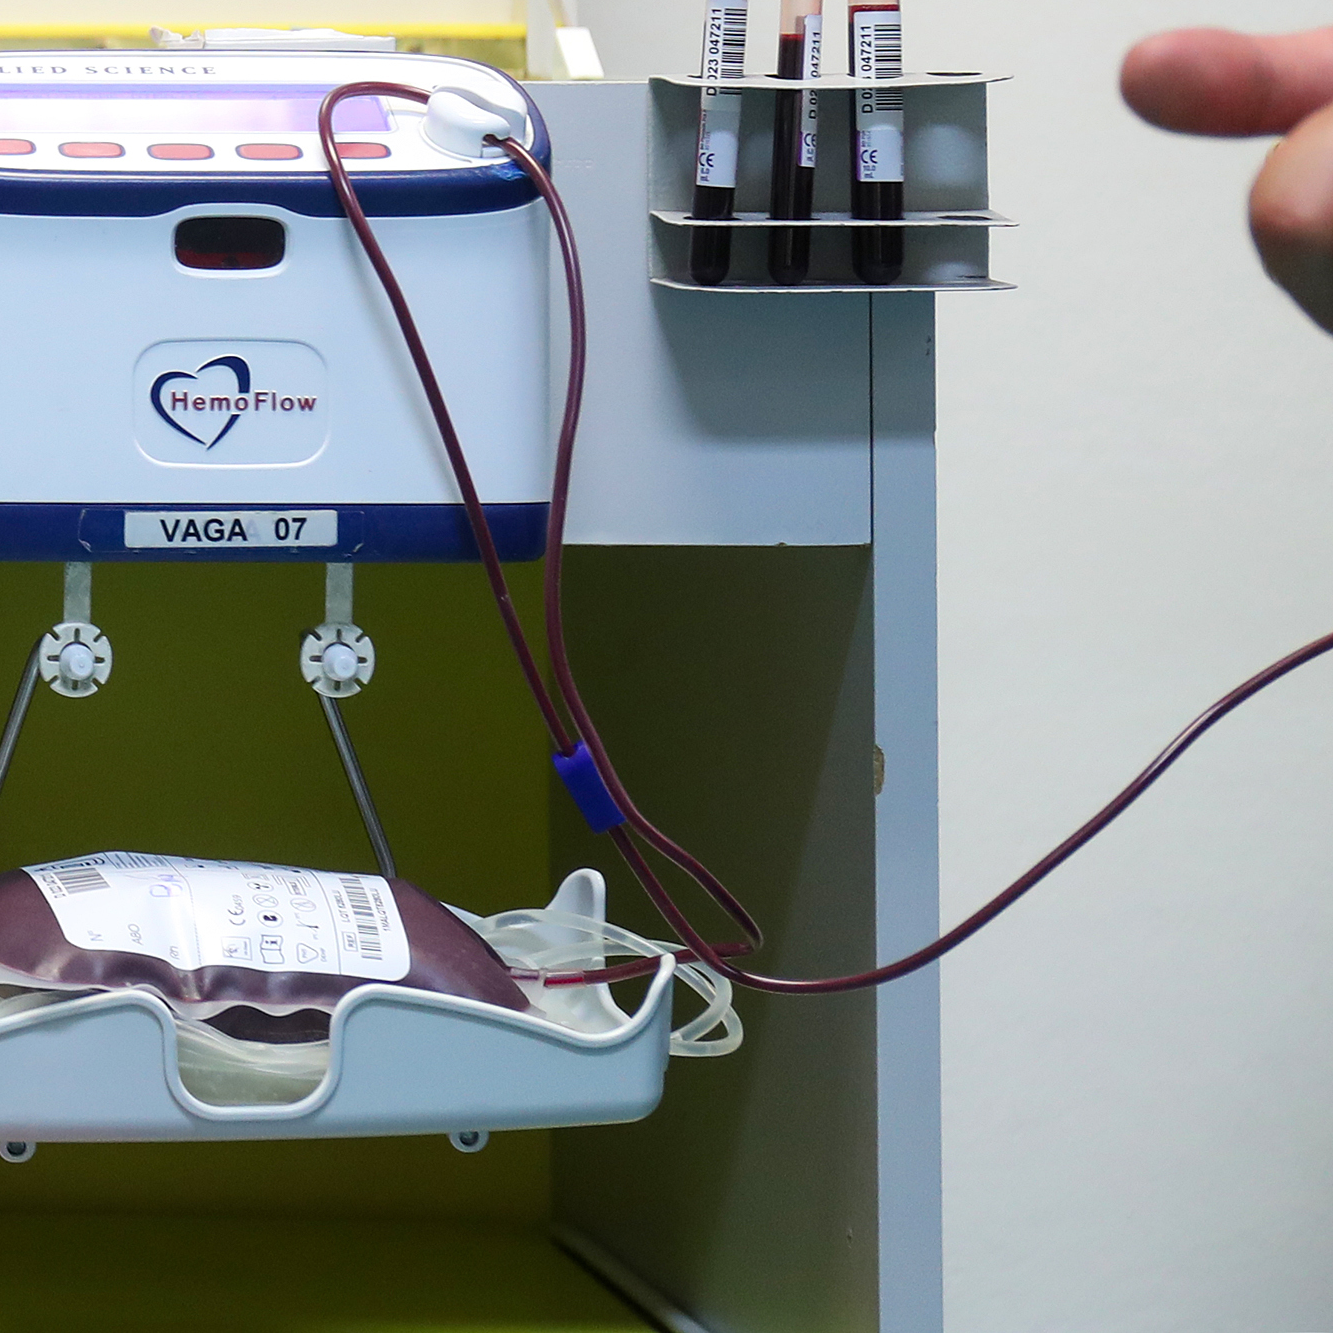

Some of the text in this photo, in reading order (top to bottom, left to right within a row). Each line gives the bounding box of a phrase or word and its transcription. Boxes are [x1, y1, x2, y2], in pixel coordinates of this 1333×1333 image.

[708, 8, 723, 55] 047211
[860, 26, 872, 72] 047211
[84, 66, 217, 76] SCIENCE
[810, 32, 822, 78] 047211
[170, 390, 318, 412] HemoFlow
[159, 517, 308, 543] VAGA 07
